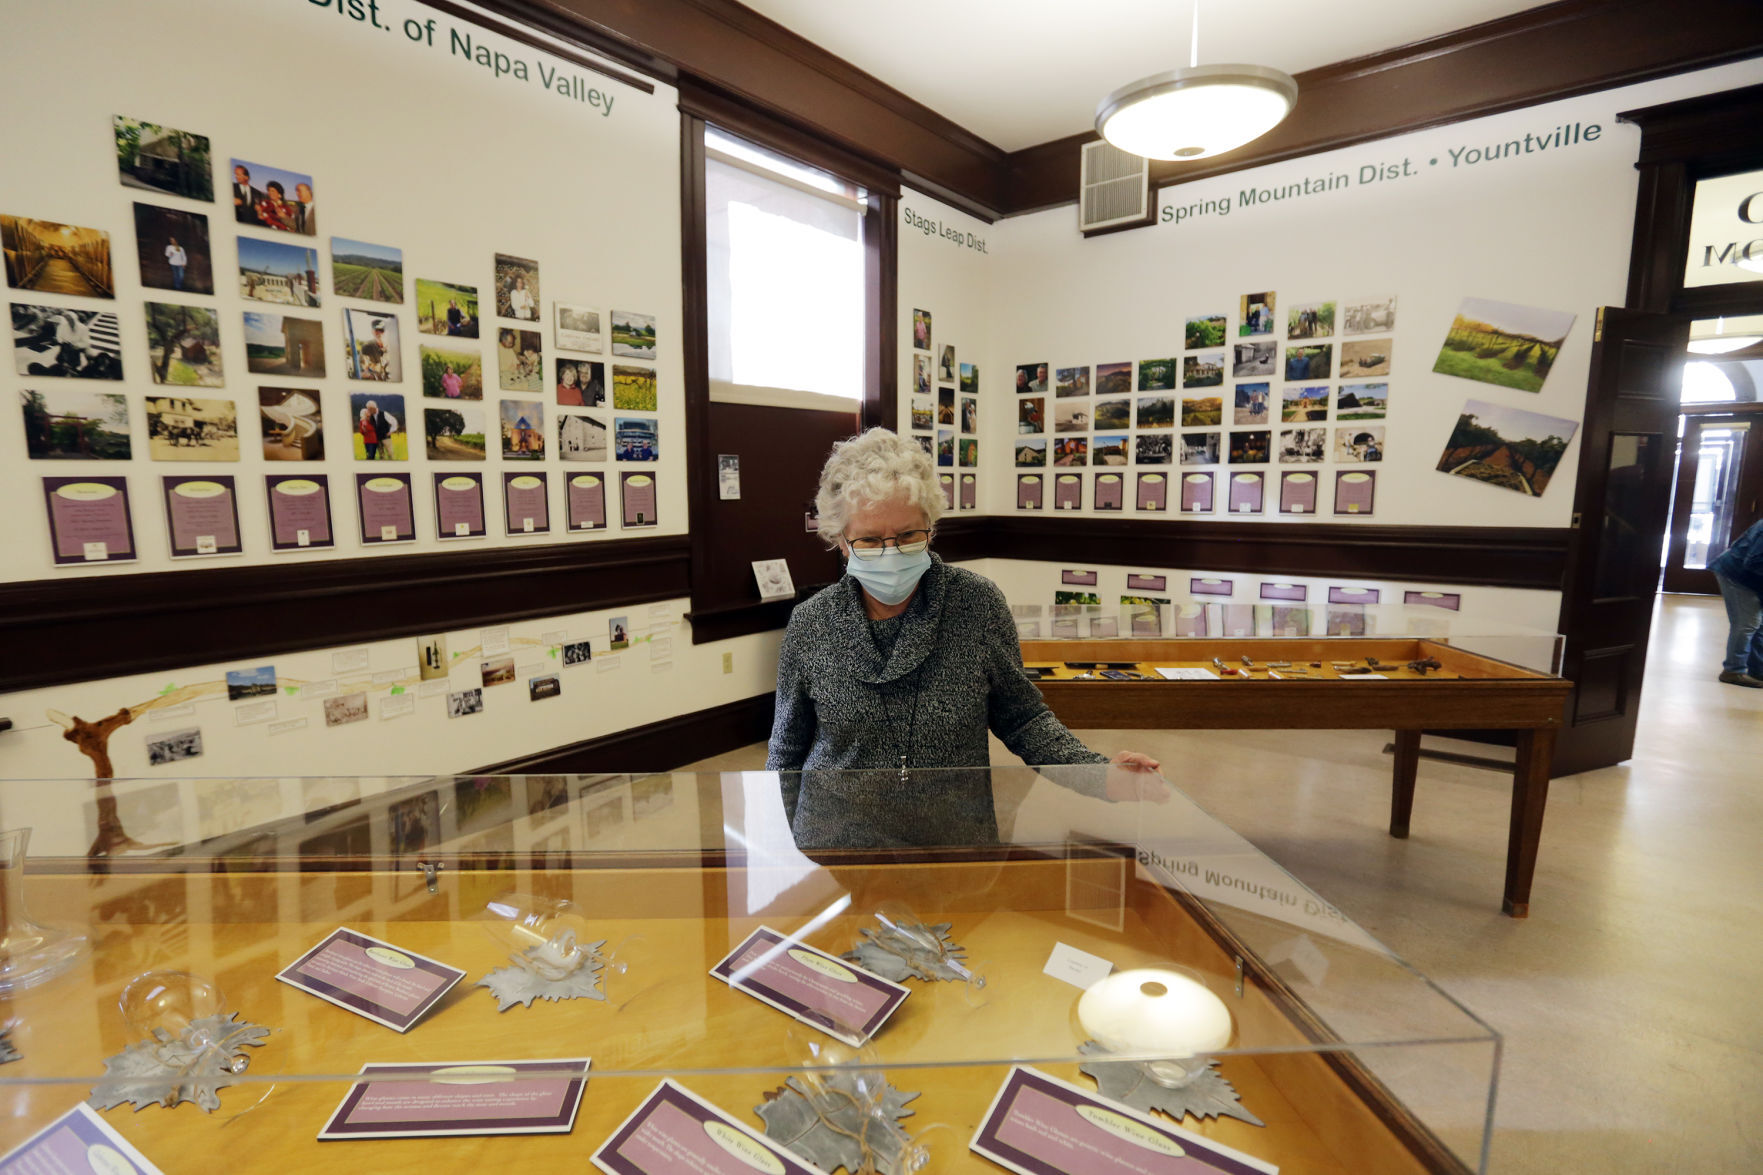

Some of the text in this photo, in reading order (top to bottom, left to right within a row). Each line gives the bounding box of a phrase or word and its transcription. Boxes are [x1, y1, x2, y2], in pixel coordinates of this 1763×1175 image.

[308, 0, 615, 117] st. of Napa Valley
[1161, 121, 1603, 225] Spring Mountain Dist. Yountville
[904, 207, 989, 254] Stags Leap Dist.
[736, 1141, 752, 1155] Wine
[1088, 1110, 1172, 1152] Tumbler Wine Glass
